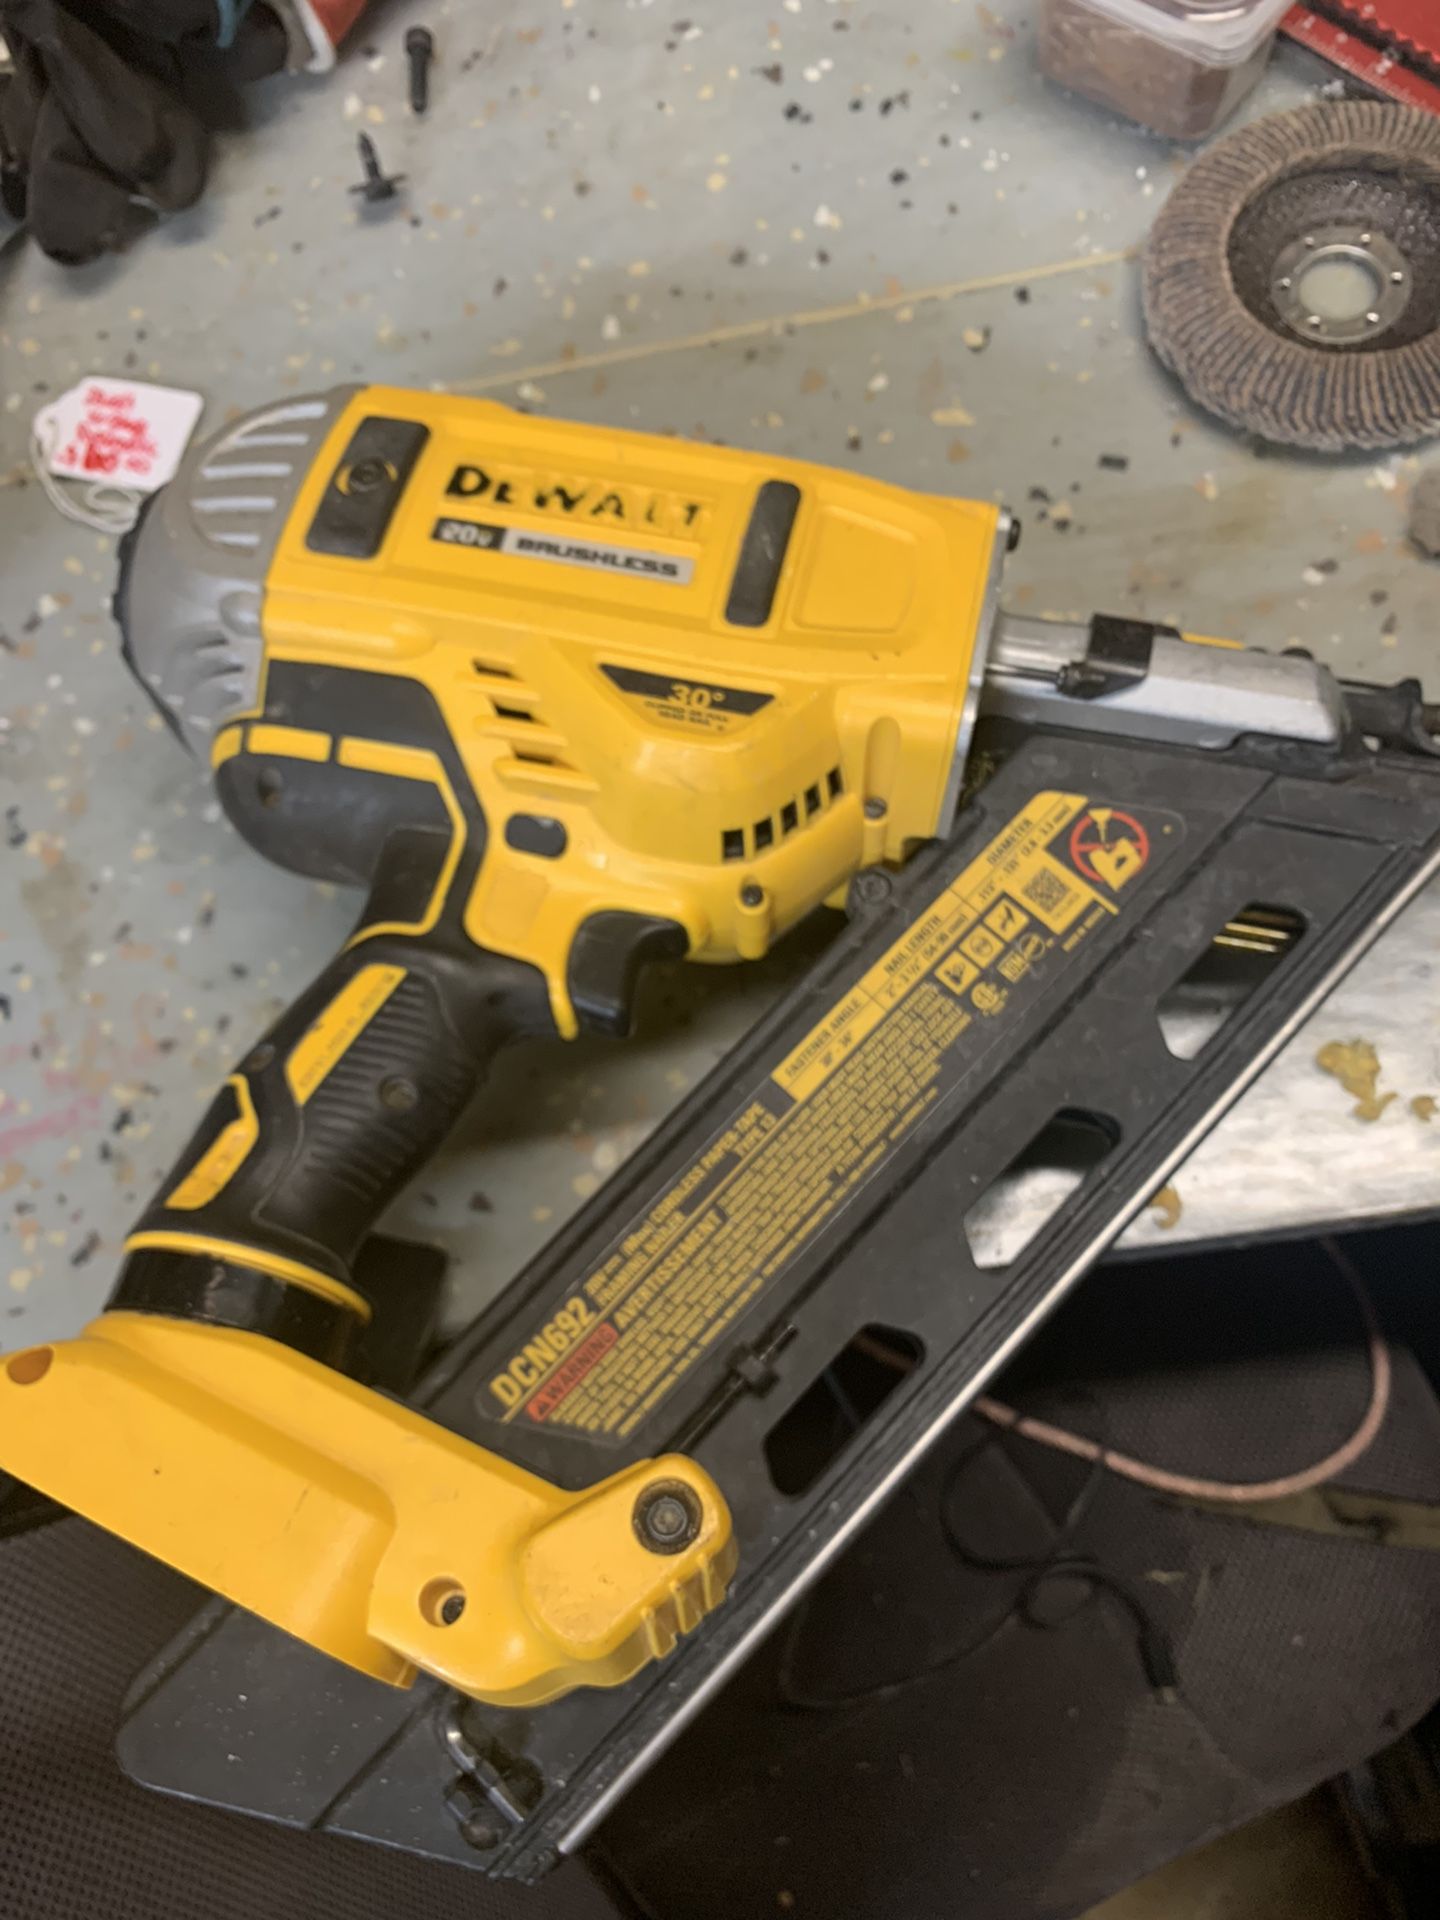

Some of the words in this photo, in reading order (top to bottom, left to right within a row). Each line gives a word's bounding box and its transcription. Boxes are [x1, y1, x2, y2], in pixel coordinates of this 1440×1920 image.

[445, 464, 708, 533] DEWALT
[515, 538, 679, 578] BRUSHLESS
[668, 683, 726, 708] 30°
[985, 816, 1033, 866] DIAMETER
[882, 950, 907, 976] NAIL
[903, 913, 942, 953] LENGTH
[783, 1027, 833, 1080] FASTENER
[827, 995, 863, 1032] ANGLE
[486, 1291, 599, 1409] DCN692
[649, 1163, 707, 1225] CORDLESS
[541, 1325, 616, 1403] WARNING
[609, 1208, 725, 1330] AVERTISSEMENT
